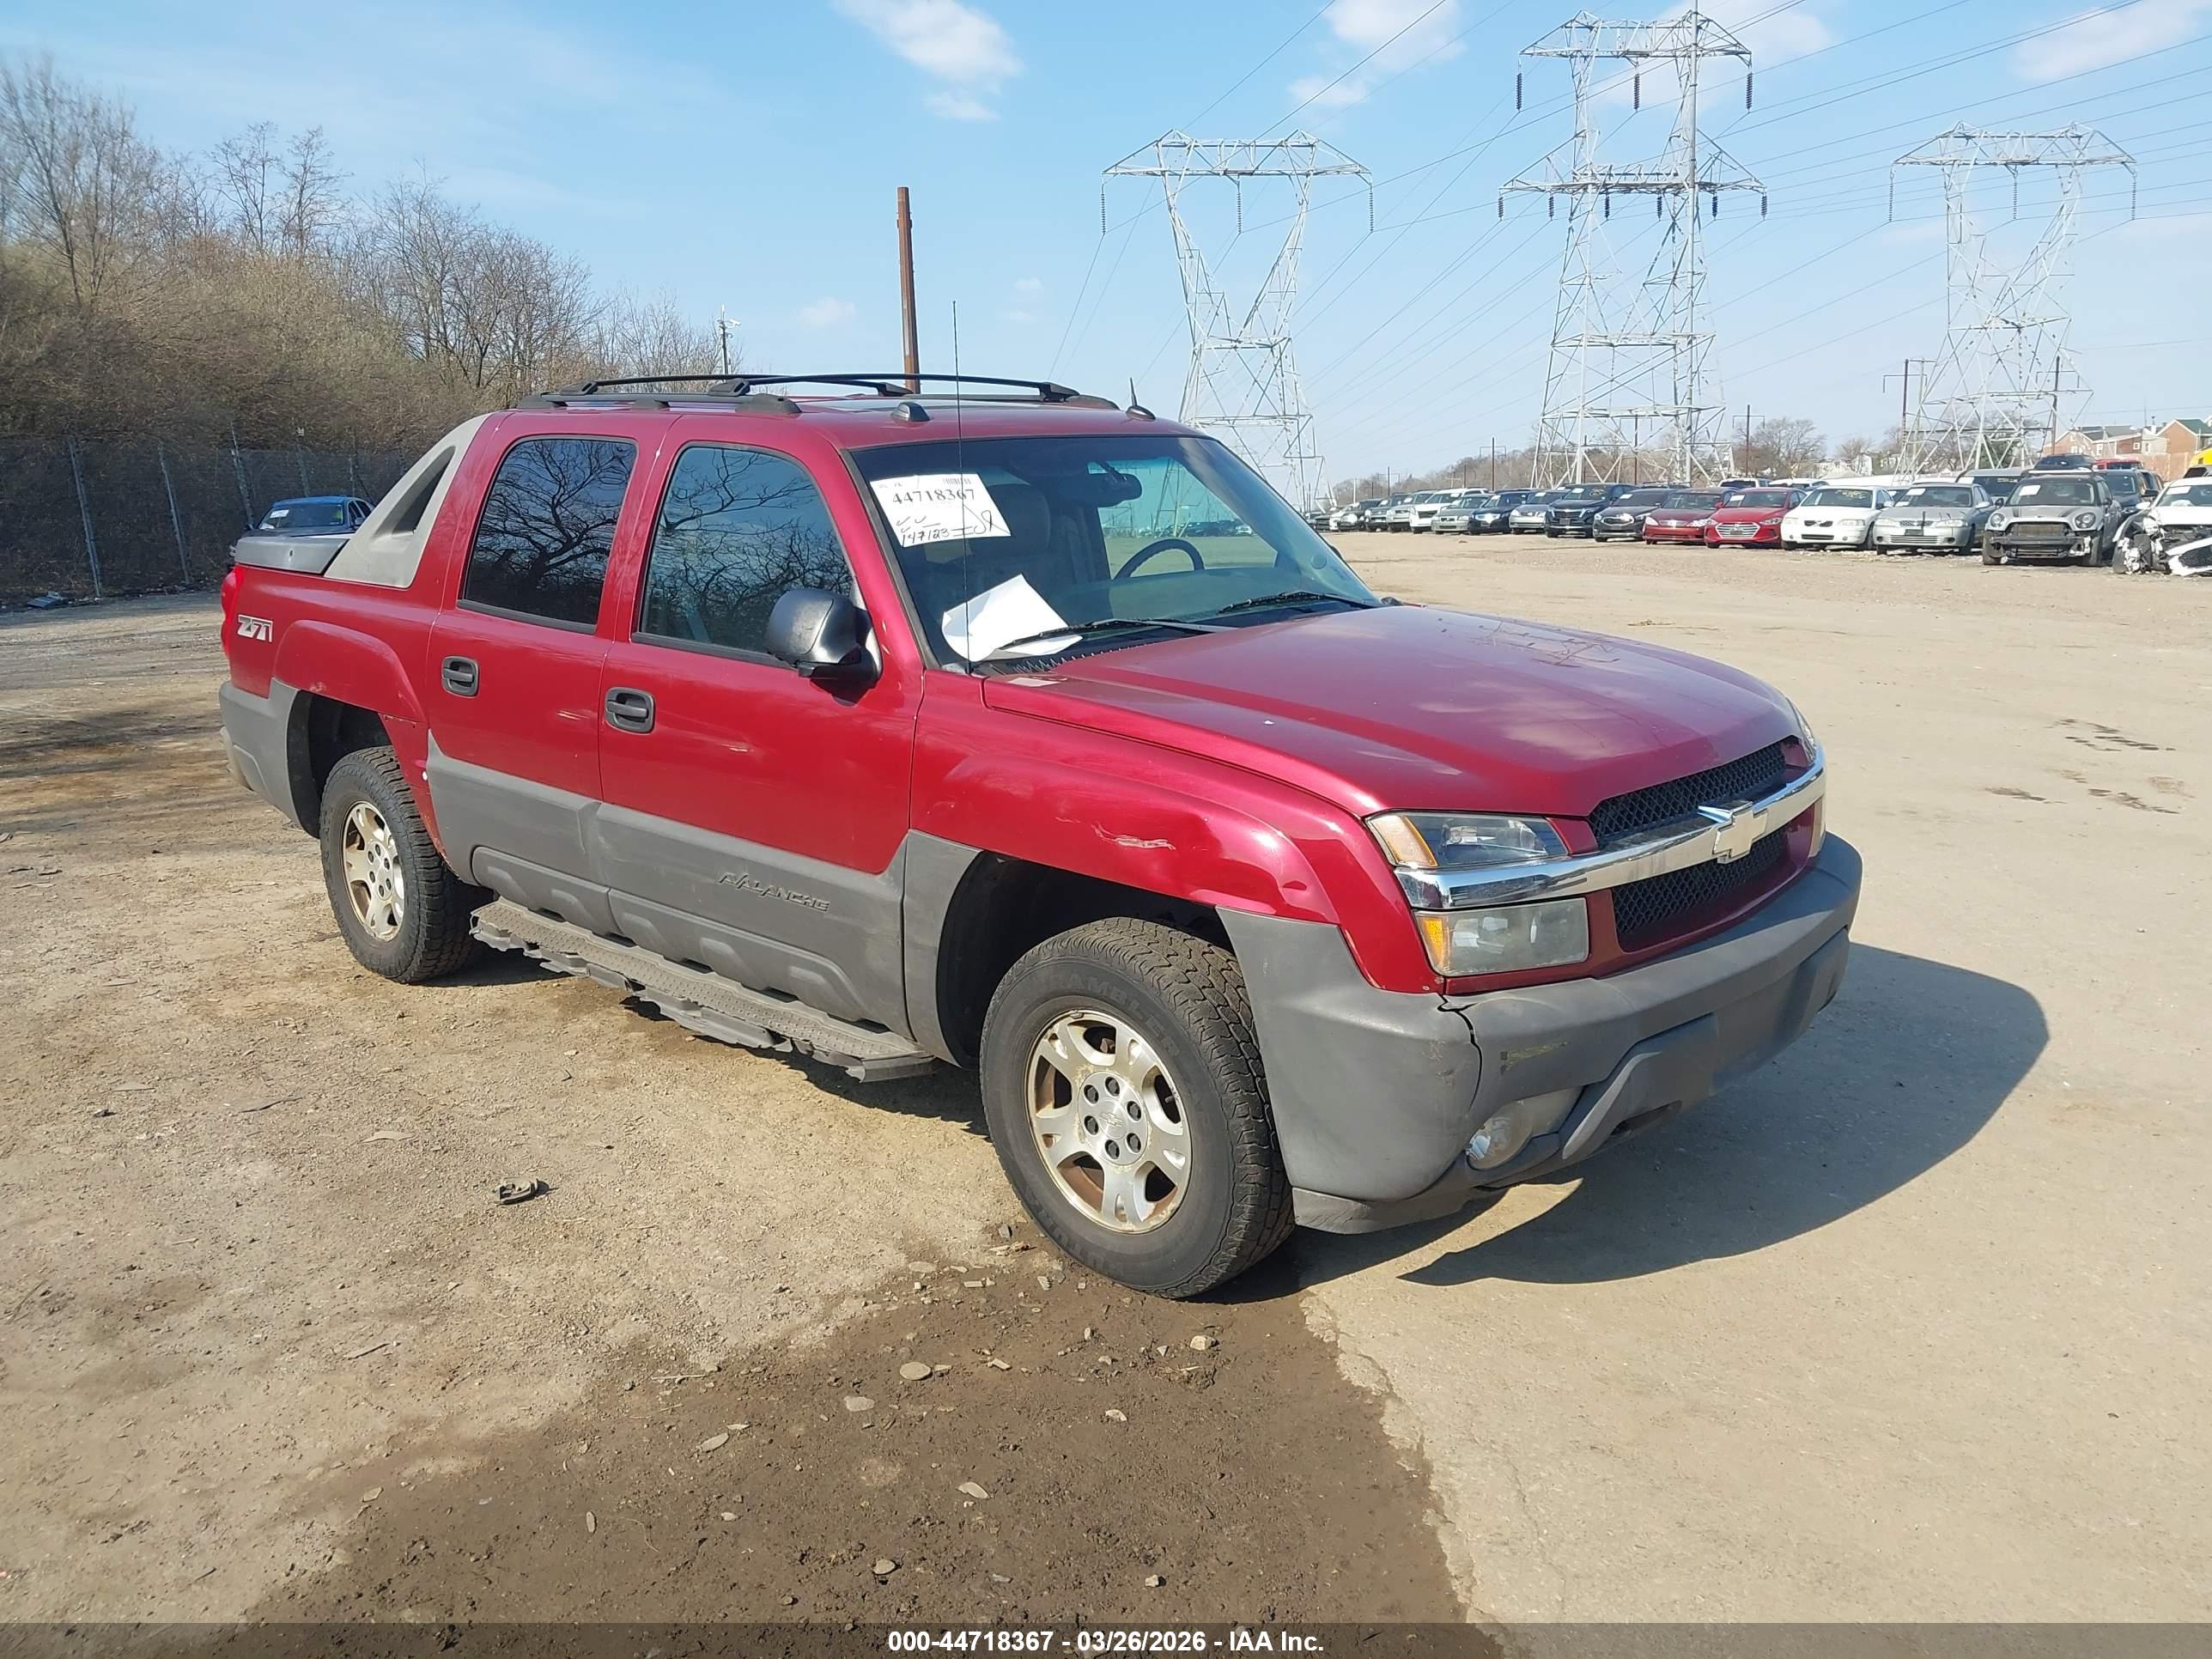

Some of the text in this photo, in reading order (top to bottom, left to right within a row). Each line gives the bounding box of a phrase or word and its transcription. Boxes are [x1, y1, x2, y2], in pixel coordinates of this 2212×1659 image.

[892, 489, 975, 505] 44718367
[237, 614, 273, 643] Z71
[716, 872, 830, 913] AVALANCHE
